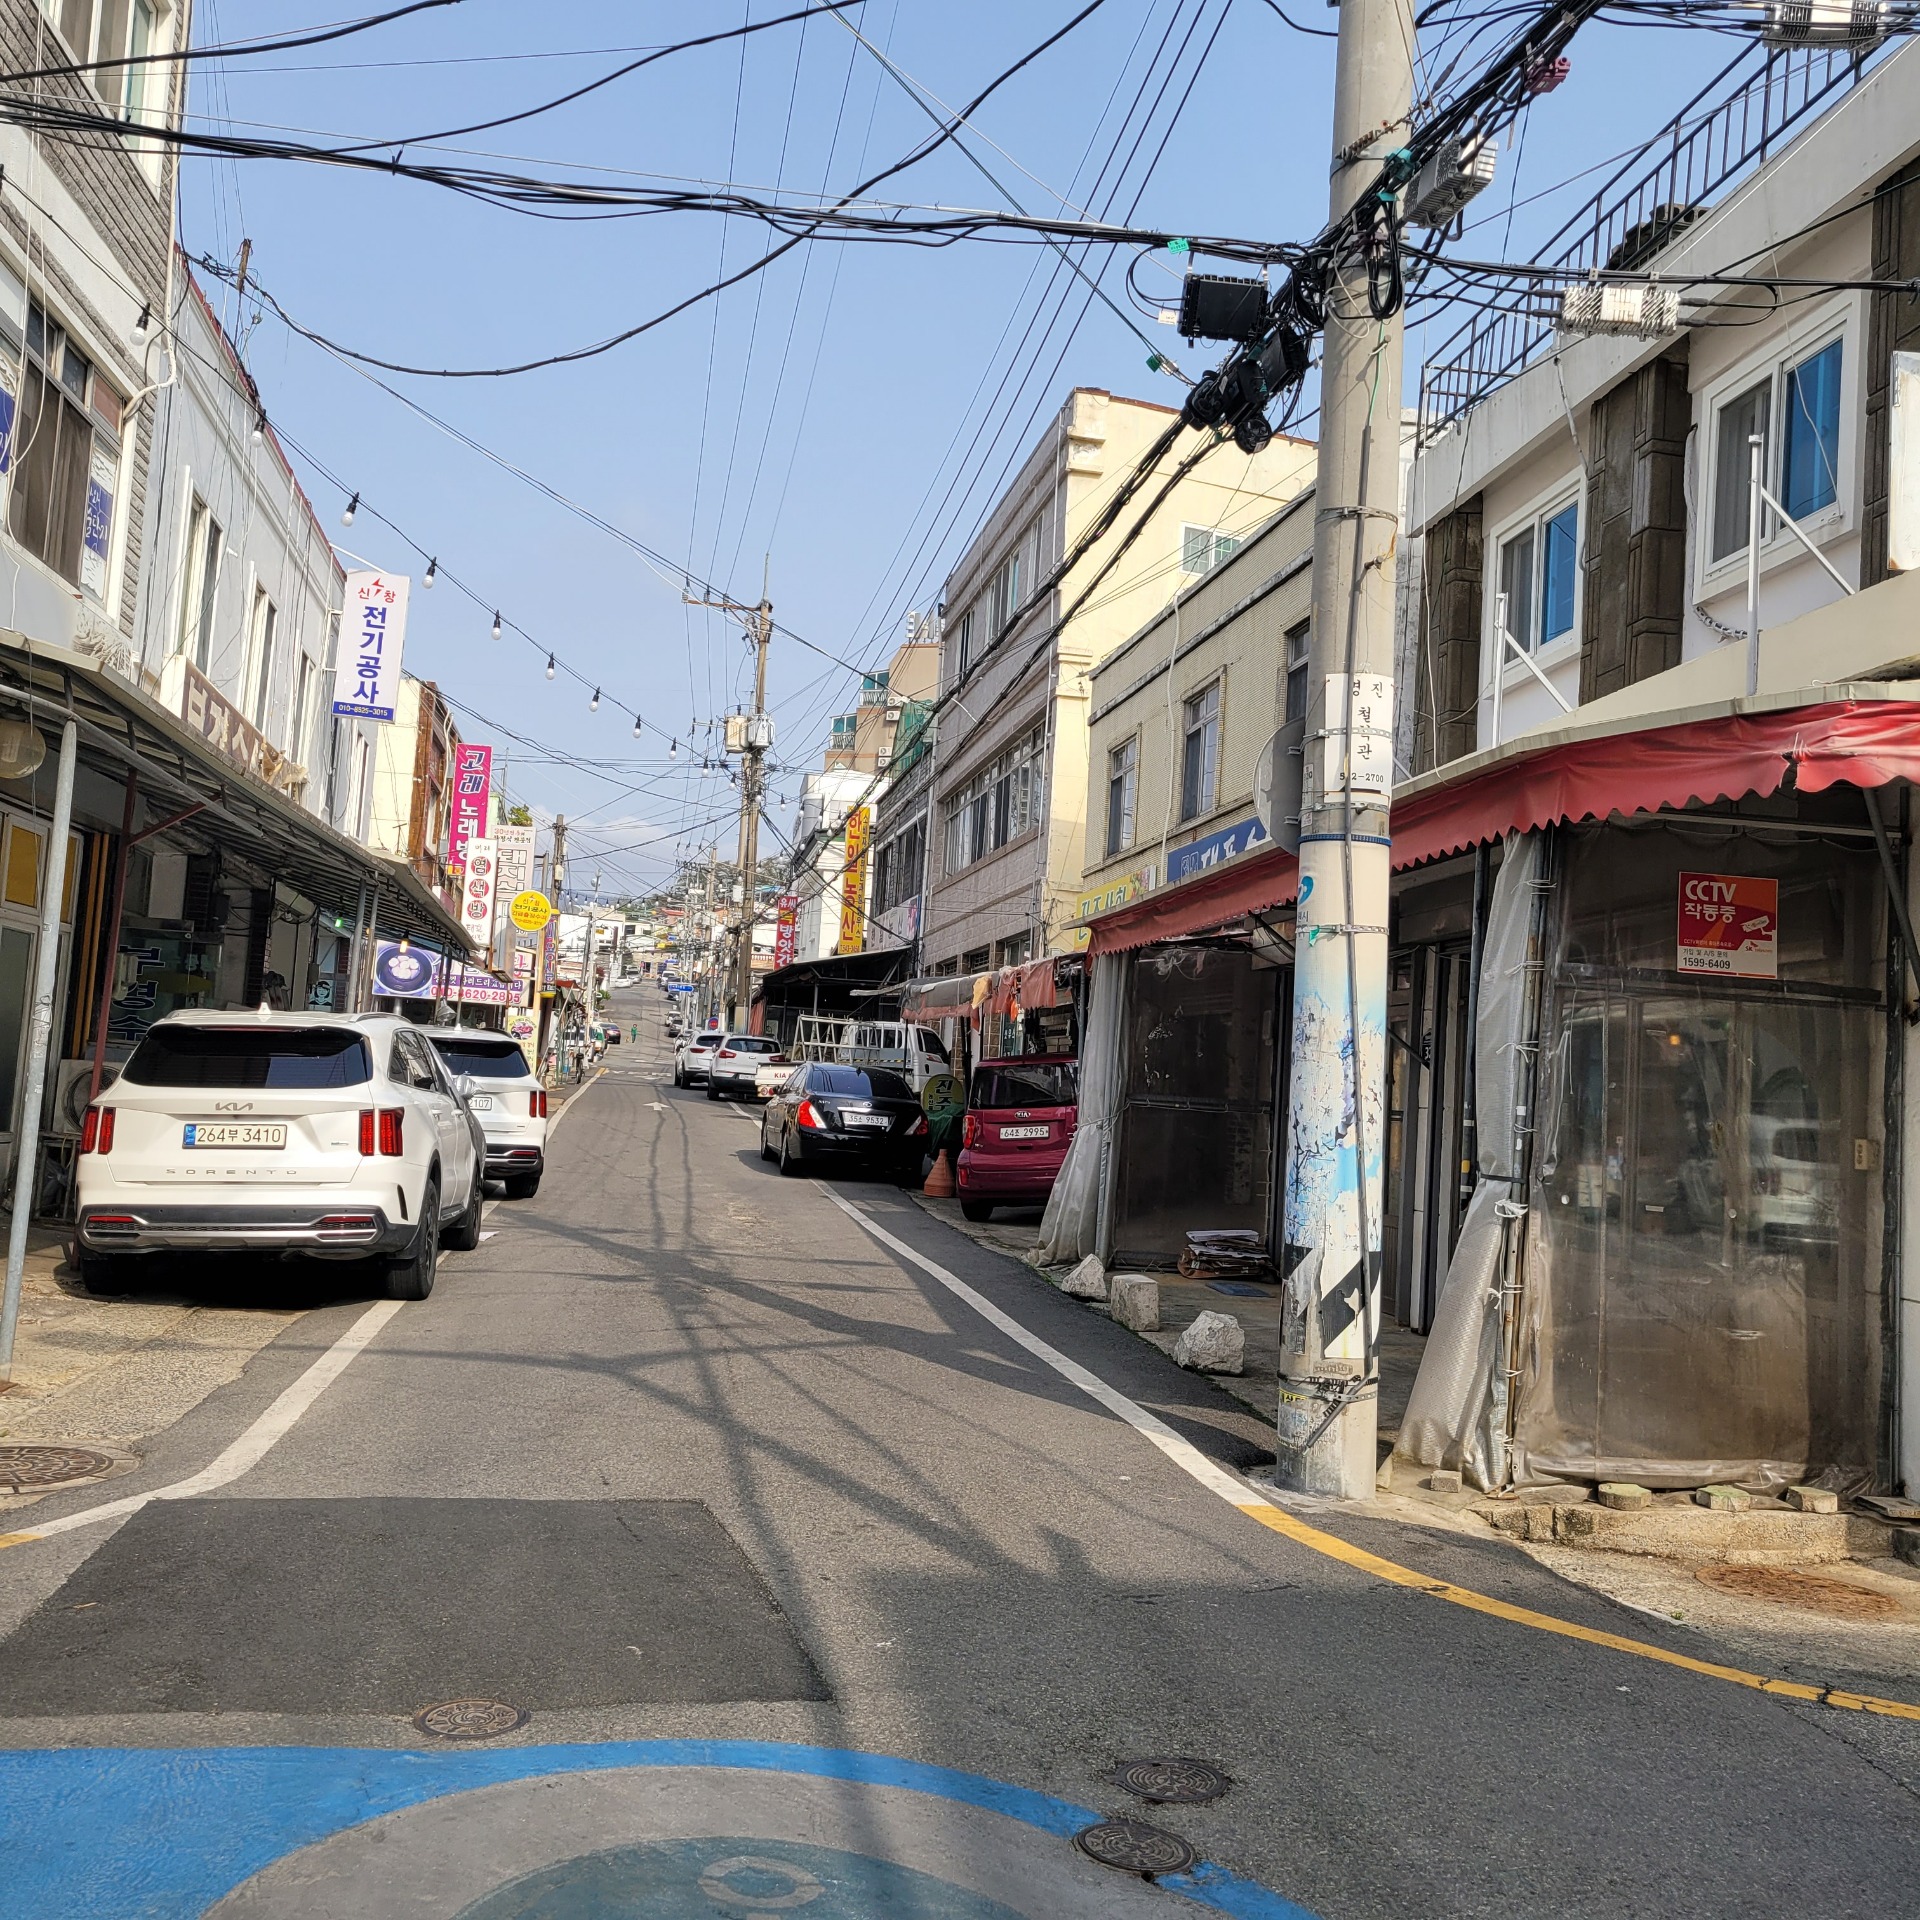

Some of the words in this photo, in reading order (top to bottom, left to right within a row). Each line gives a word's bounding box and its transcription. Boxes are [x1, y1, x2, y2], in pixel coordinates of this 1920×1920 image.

[358, 587, 396, 603] 신창
[352, 605, 387, 704] 전기공사
[338, 703, 388, 716] 010-8525-3015
[458, 750, 485, 794] 고래
[1339, 772, 1384, 783] 52-2700
[842, 809, 862, 941] 한일농산
[469, 857, 488, 918] 염색방
[1685, 880, 1736, 903] CCTV
[1685, 902, 1736, 923] 작동중
[1683, 957, 1730, 969] 1599-6409
[935, 1080, 954, 1110] 진주
[215, 1102, 254, 1111] KIA
[866, 1116, 884, 1125] 9532
[197, 1127, 238, 1143] 264부
[242, 1127, 281, 1143] 3410
[1023, 1127, 1045, 1136] 2995
